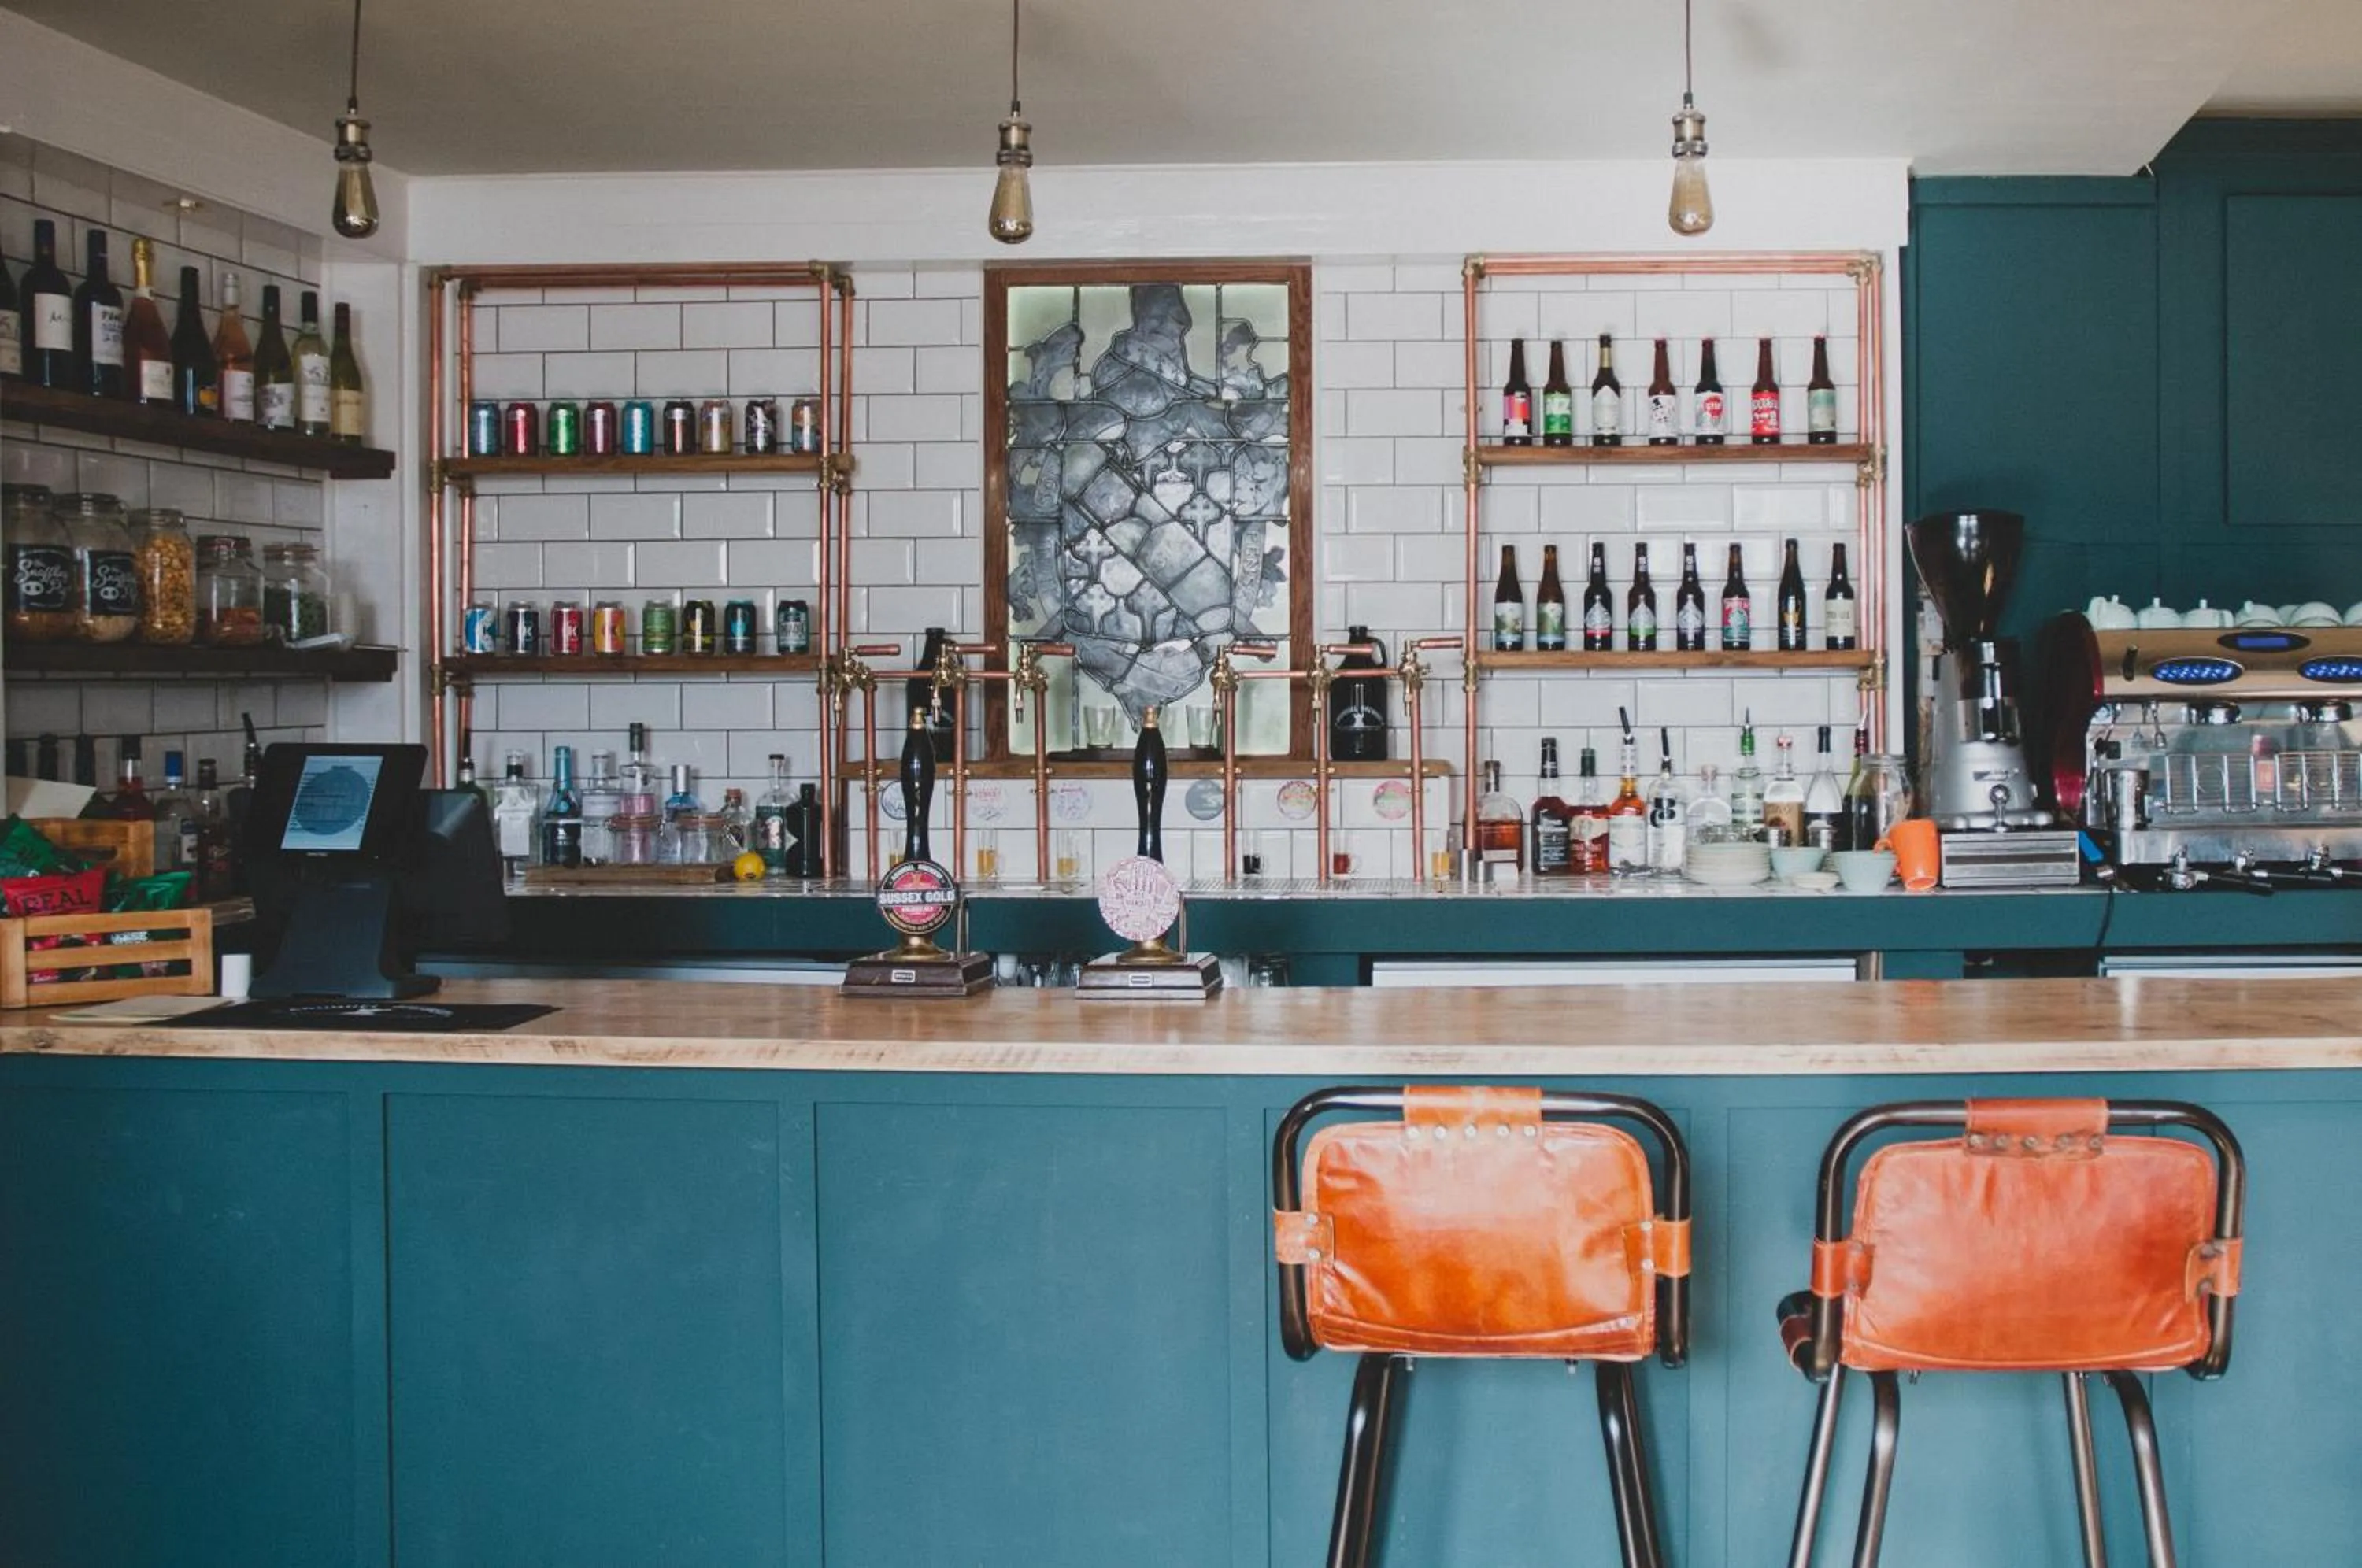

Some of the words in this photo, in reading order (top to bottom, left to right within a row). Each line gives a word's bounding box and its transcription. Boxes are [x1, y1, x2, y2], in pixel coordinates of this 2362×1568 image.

[22, 889, 91, 915] REAL
[879, 892, 922, 904] SUSSEX
[925, 889, 956, 904] GOLD
